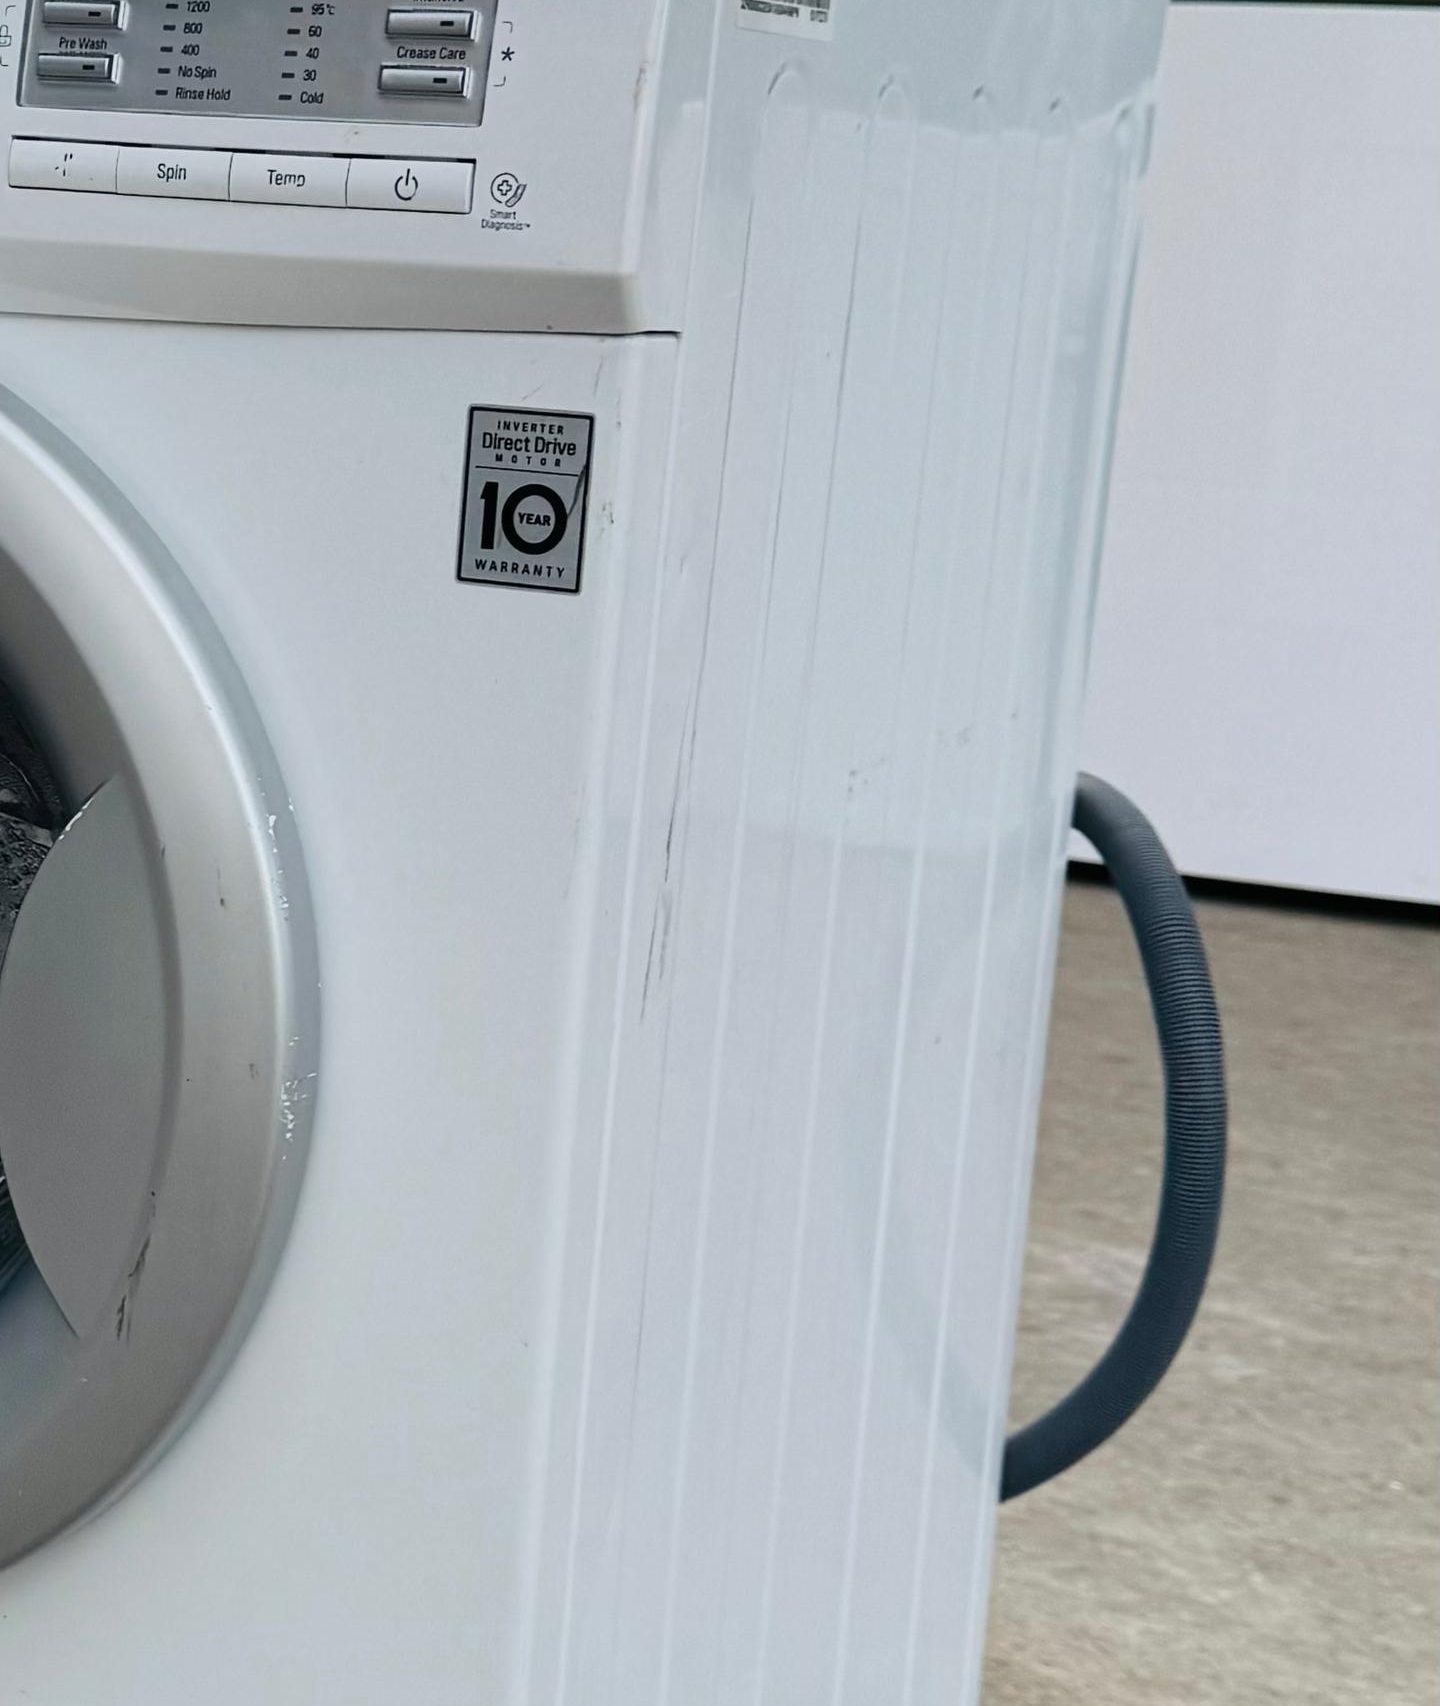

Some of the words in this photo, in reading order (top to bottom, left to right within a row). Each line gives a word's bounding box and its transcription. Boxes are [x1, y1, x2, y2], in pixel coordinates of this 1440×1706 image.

[186, 0, 211, 13] 1200
[183, 22, 203, 35] 800
[308, 25, 322, 38] 60
[59, 36, 77, 49] Pre
[79, 37, 108, 50] Wash
[180, 44, 200, 56] 400
[305, 47, 320, 60] 40
[396, 46, 436, 60] Crease
[439, 47, 467, 61] Care
[177, 65, 193, 78] No
[194, 66, 217, 80] Spin
[302, 69, 317, 82] 30
[175, 87, 204, 100] Rinse
[206, 88, 231, 101] Hold
[299, 91, 324, 104] Cold
[156, 163, 187, 183] Spin
[267, 169, 306, 188] Temp
[497, 420, 565, 435] INVERTER
[482, 431, 531, 454] Direct
[534, 436, 577, 457] Drive
[479, 481, 568, 556] 10
[518, 511, 551, 527] YEAR
[474, 558, 566, 579] WARRANTY
